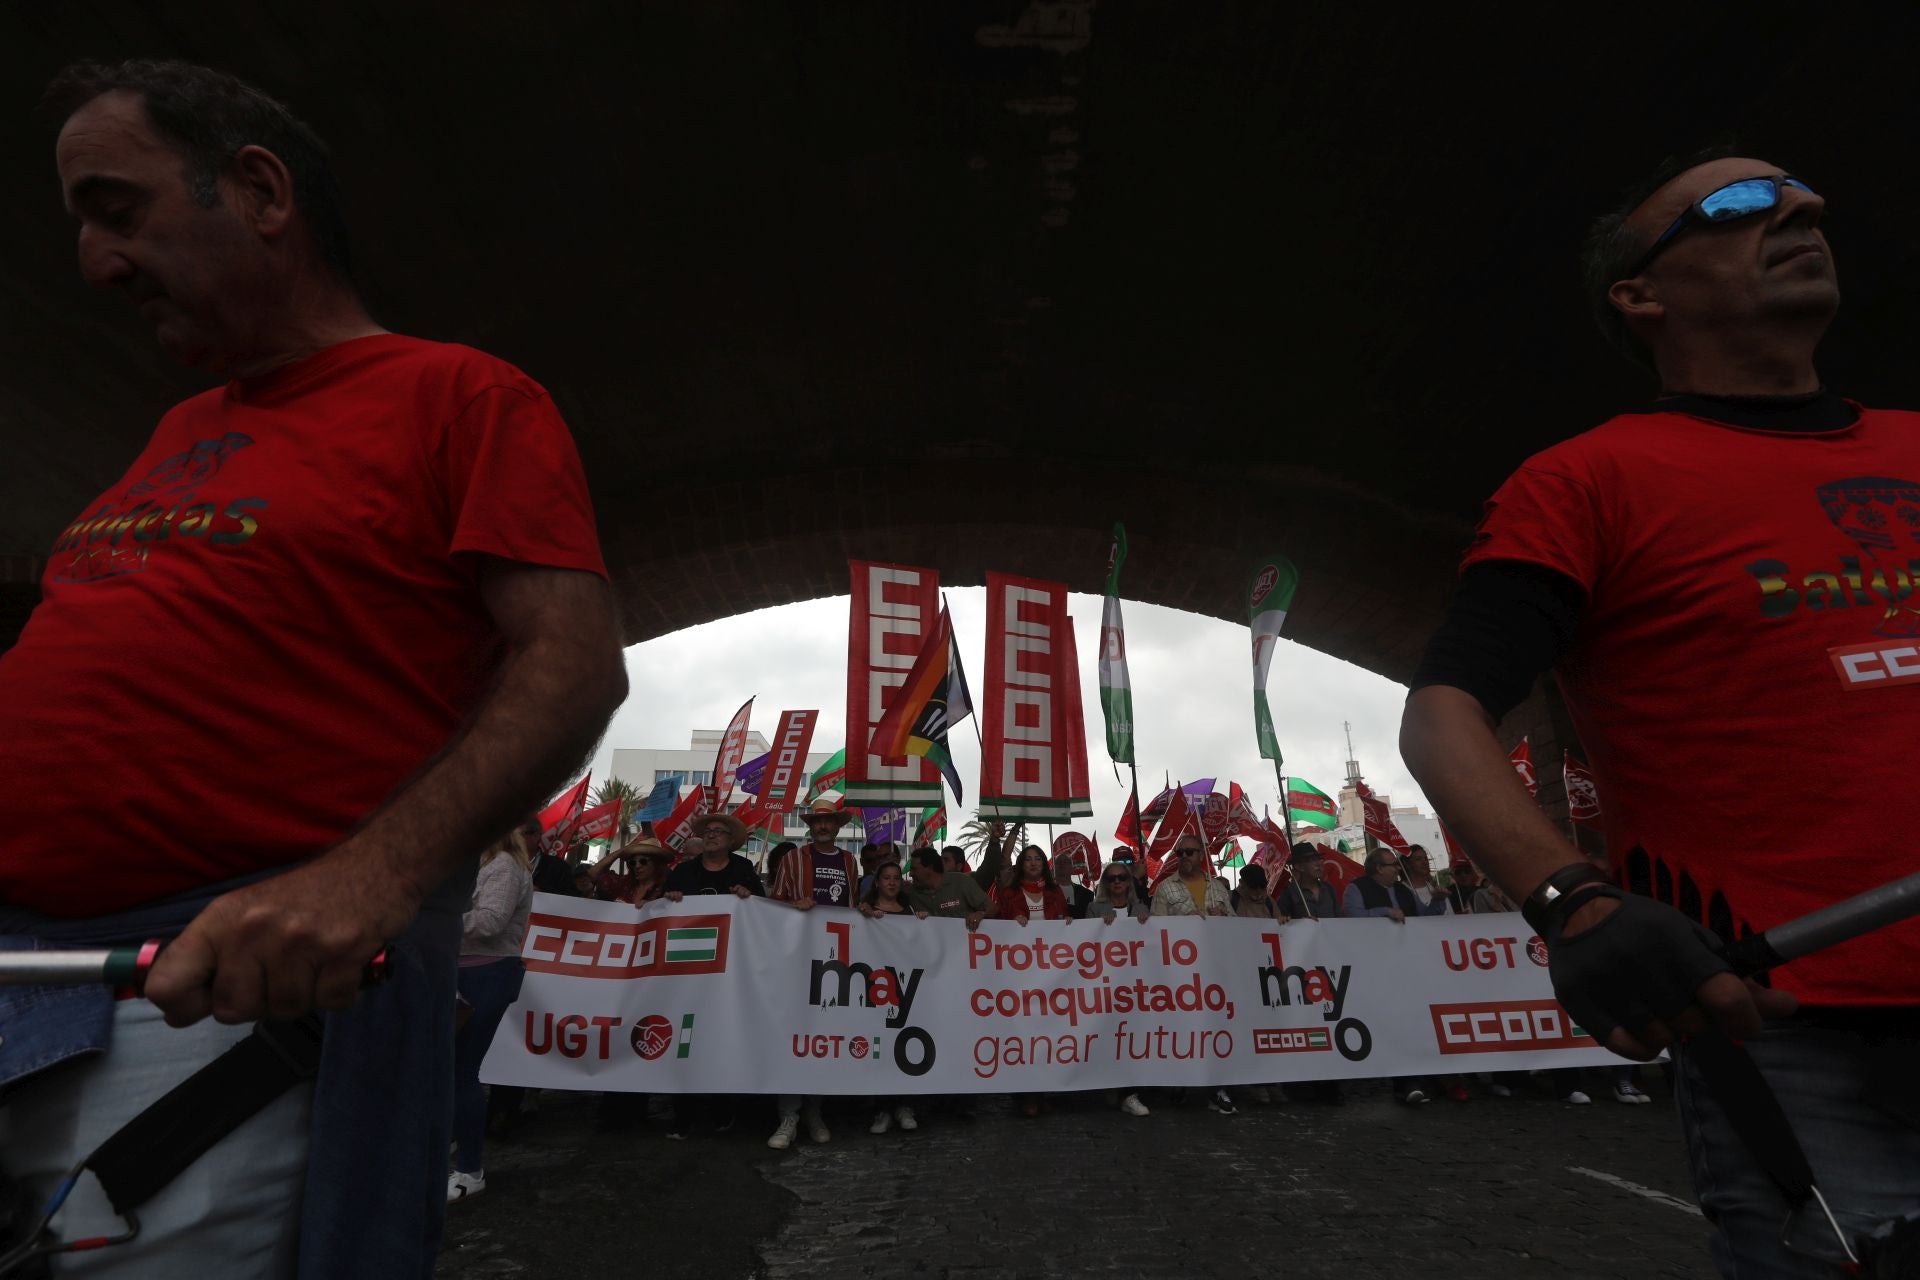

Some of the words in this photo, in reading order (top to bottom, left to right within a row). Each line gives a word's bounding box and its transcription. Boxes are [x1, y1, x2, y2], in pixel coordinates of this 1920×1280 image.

[1839, 646, 1920, 683] CC
[1002, 584, 1052, 797] CCOO
[771, 712, 807, 786] CCOO
[522, 924, 657, 968] CCOO
[826, 921, 850, 967] 1
[968, 933, 1144, 979] Proteger
[1160, 929, 1198, 966] lo
[1261, 933, 1284, 970] 1
[1441, 937, 1518, 971] UGT
[970, 973, 1235, 1026] conquistado,
[525, 1010, 622, 1060] UGT
[792, 1034, 845, 1058] UGT
[973, 1032, 1099, 1078] ganar
[1114, 1020, 1234, 1060] futuro
[1256, 1032, 1307, 1049] CCOO
[1440, 1009, 1563, 1044] CCOO
